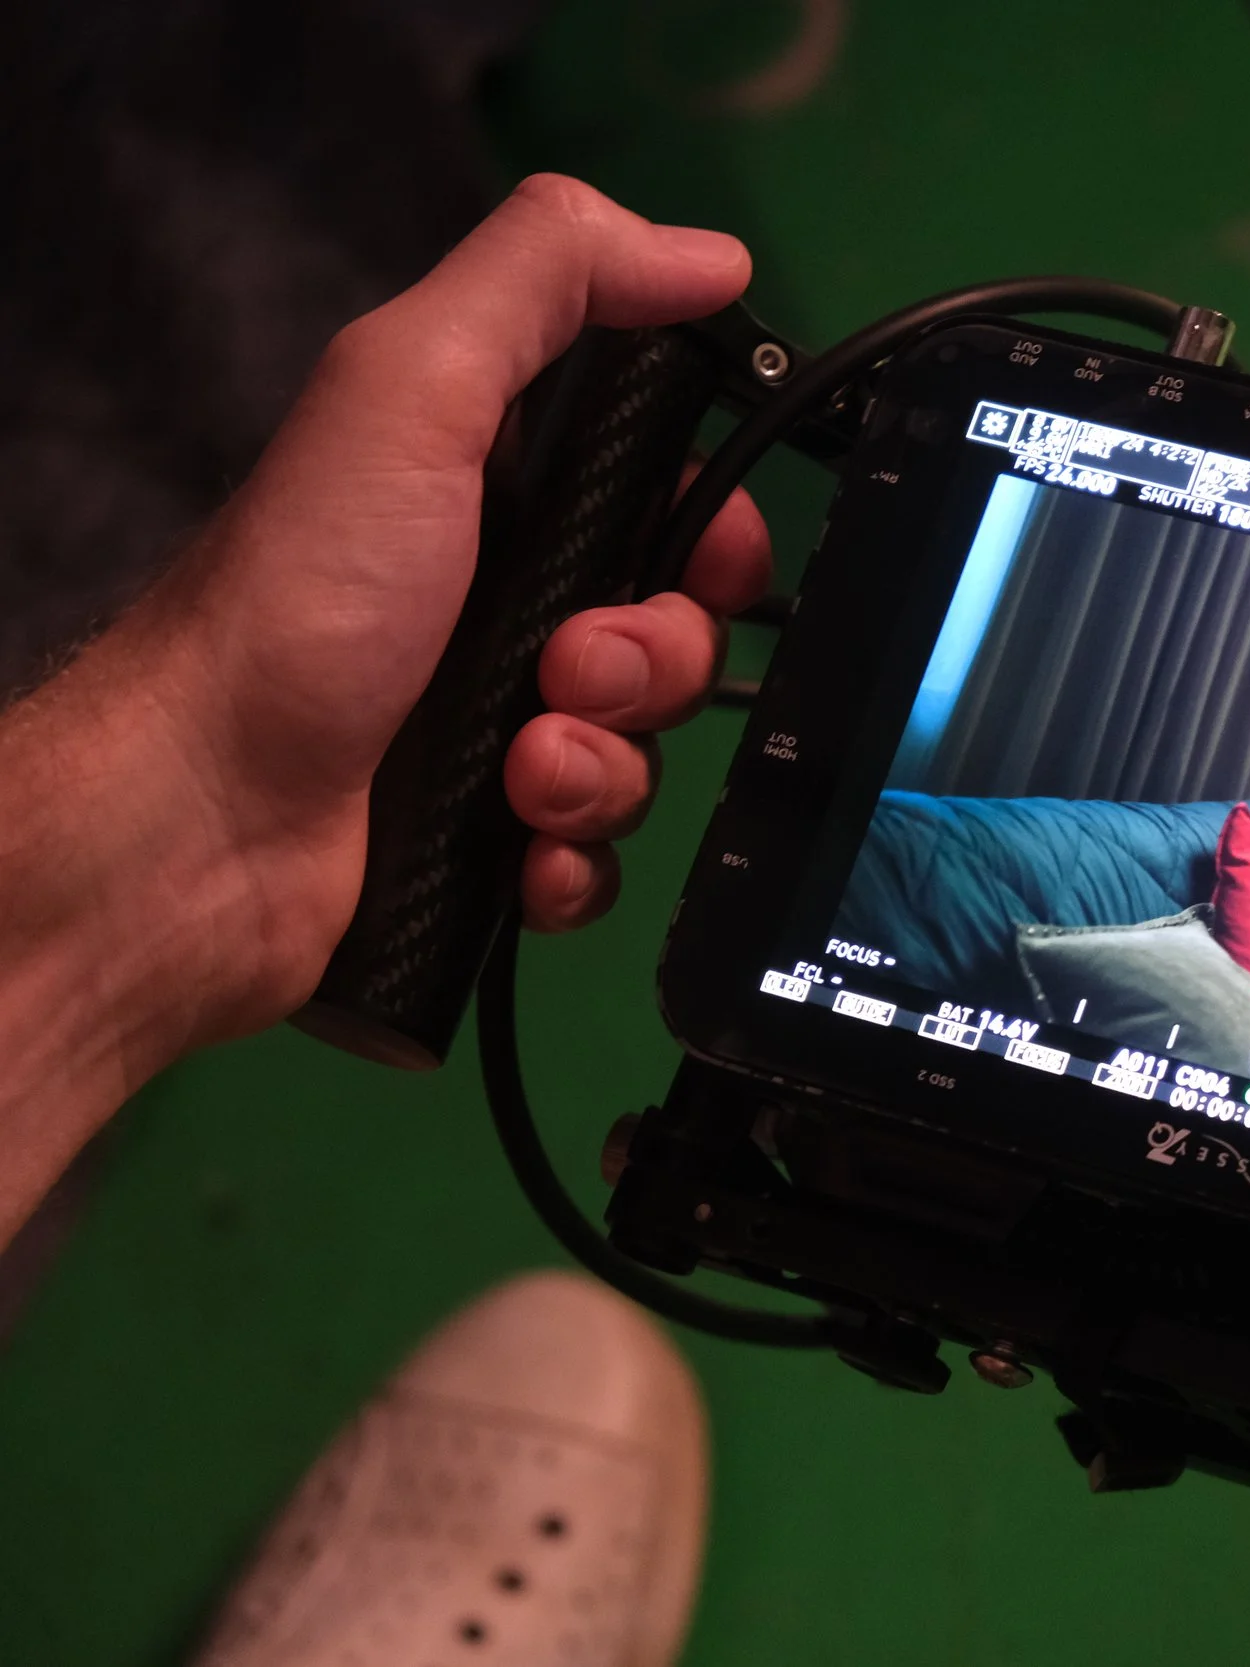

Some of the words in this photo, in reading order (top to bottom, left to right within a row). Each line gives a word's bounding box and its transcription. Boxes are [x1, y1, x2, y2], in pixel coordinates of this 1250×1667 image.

[1013, 340, 1042, 354] OUT
[1009, 351, 1039, 366] AUD
[1085, 357, 1101, 369] IN
[1074, 367, 1103, 382] AUD
[1155, 375, 1184, 389] OUT
[1147, 385, 1159, 396] B
[1160, 389, 1183, 402] SDI
[1013, 452, 1048, 475] FPS
[1045, 460, 1117, 495] 24.000
[1139, 486, 1215, 515] SHUTTER
[767, 732, 797, 747] OUT
[763, 743, 797, 760] HDMI
[722, 852, 748, 868] USB
[825, 938, 880, 966] FOCUS
[792, 961, 824, 984] FCL
[937, 1001, 974, 1024] BAT
[980, 1010, 1038, 1042] 14.6V
[1110, 1048, 1168, 1079] A011
[917, 1069, 927, 1081] 2
[928, 1073, 955, 1089] SSD
